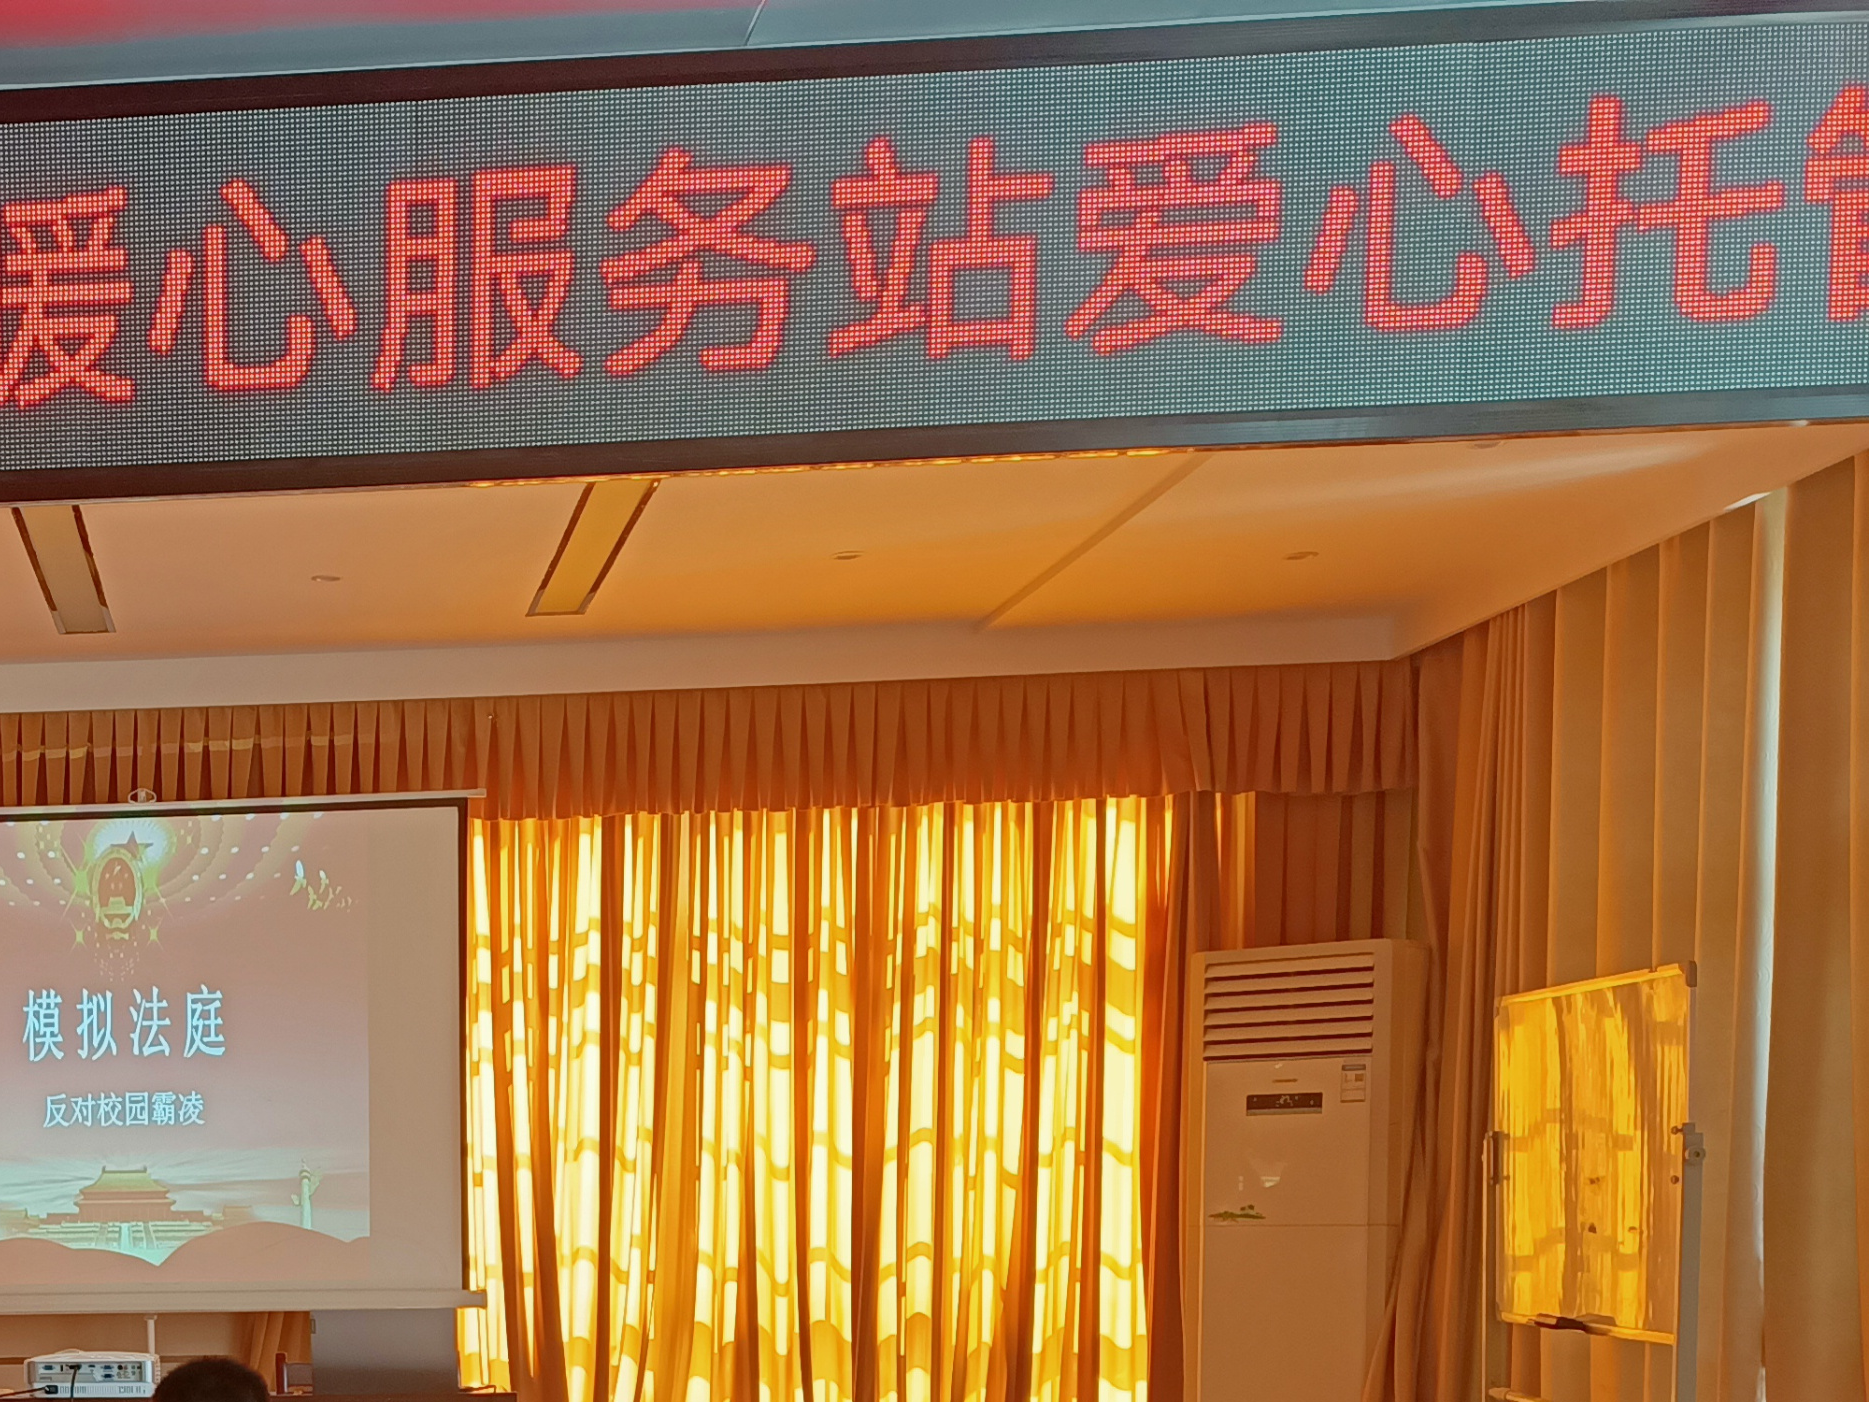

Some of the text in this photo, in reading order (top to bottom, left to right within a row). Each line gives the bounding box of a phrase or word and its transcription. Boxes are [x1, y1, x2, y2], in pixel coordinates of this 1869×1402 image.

[22, 984, 226, 1062] 模拟法庭
[43, 1091, 205, 1128] 反对校园霸凌
